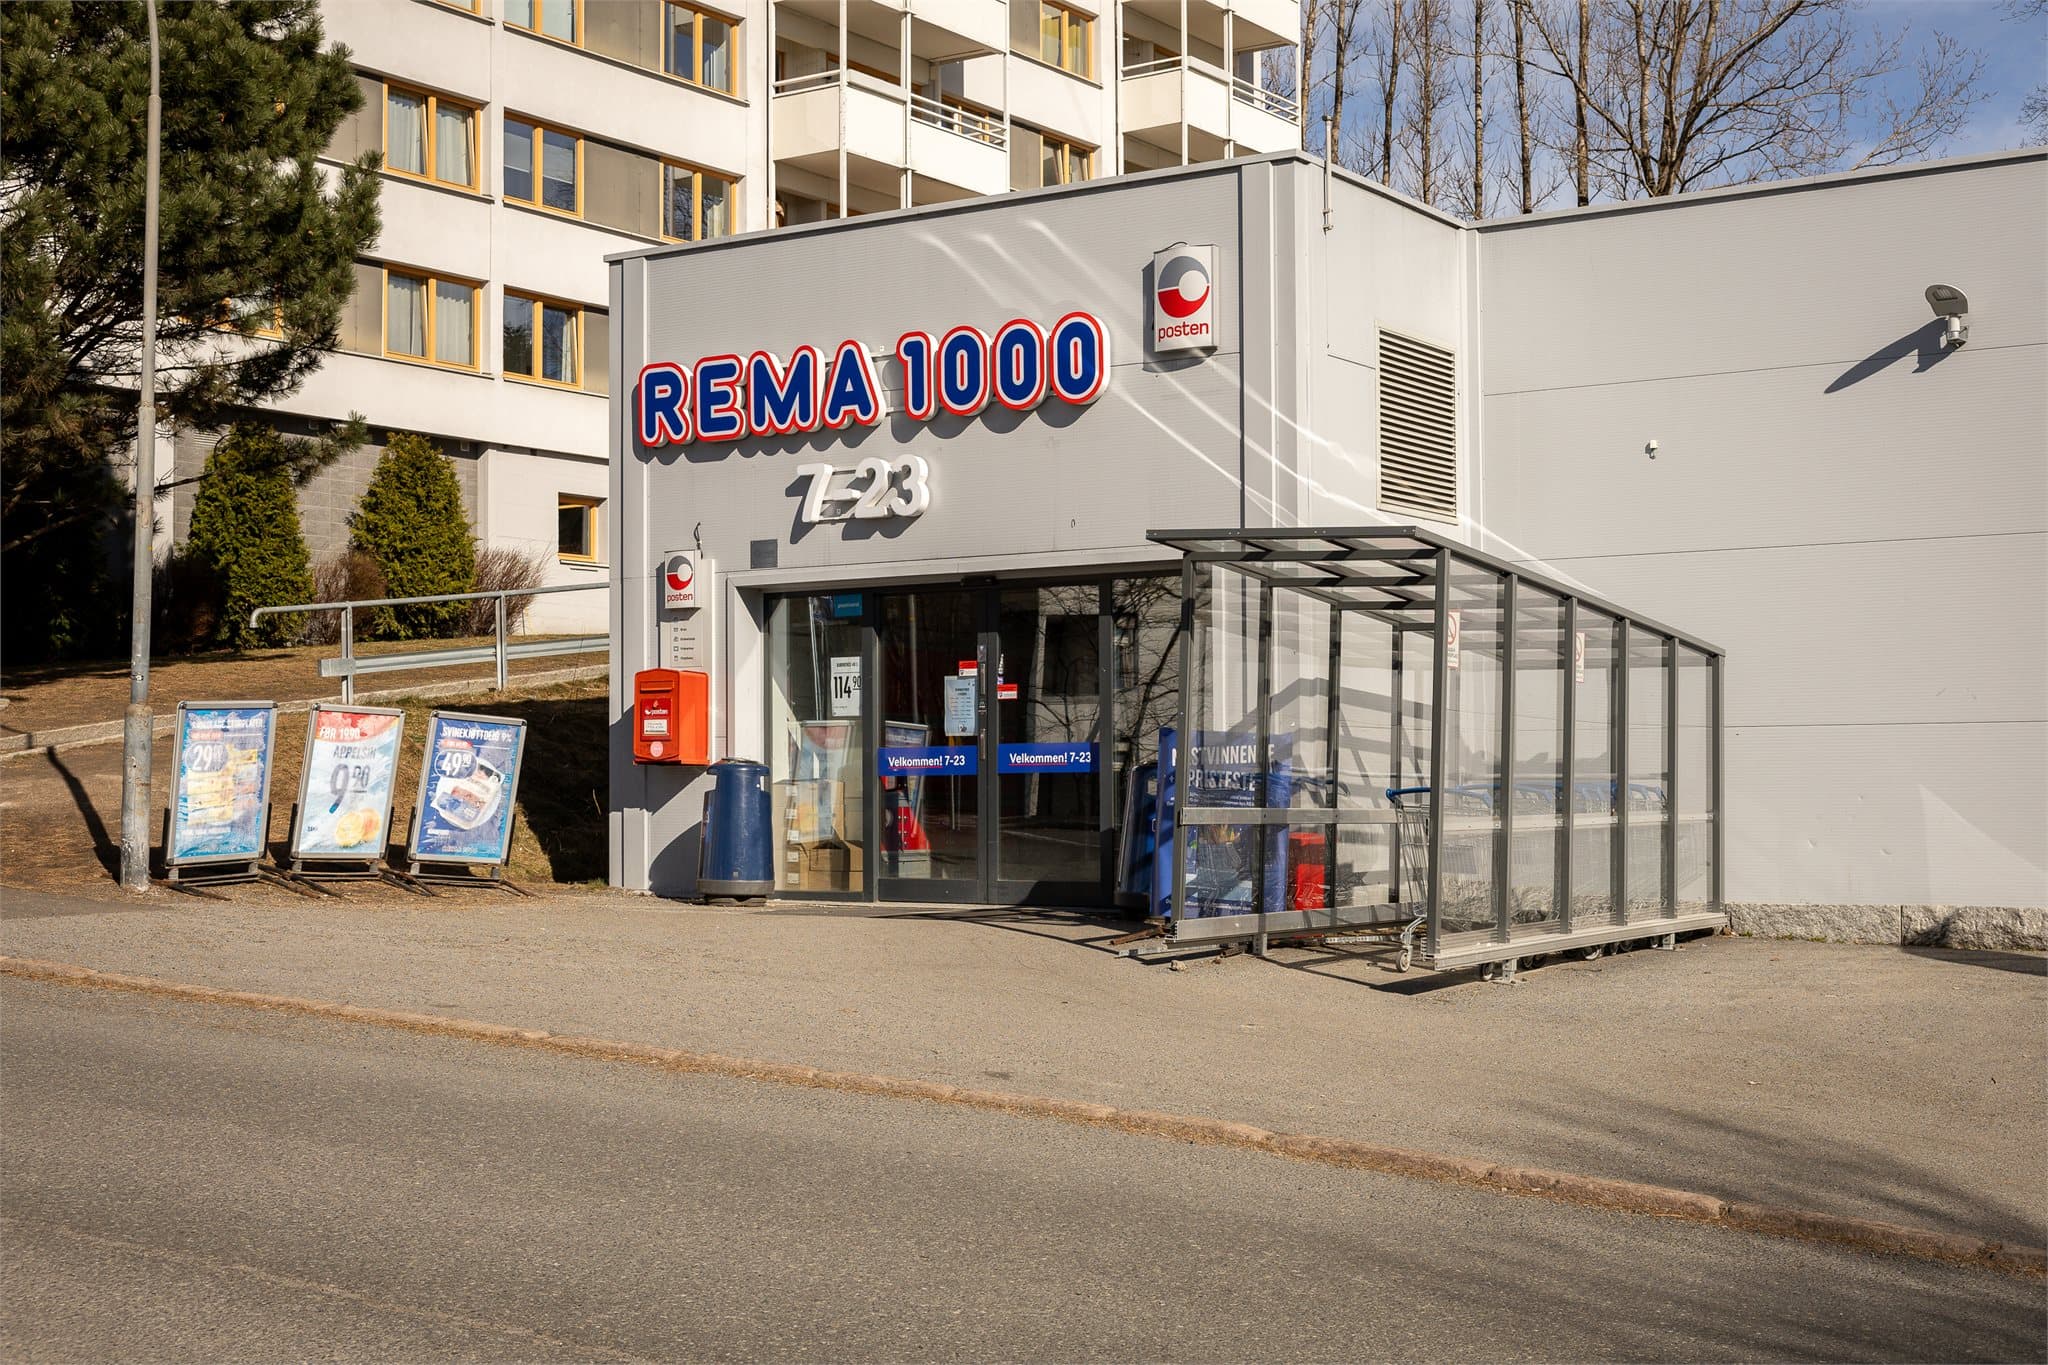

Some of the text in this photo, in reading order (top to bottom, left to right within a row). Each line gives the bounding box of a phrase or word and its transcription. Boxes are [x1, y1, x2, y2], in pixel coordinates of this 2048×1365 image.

[1159, 321, 1209, 343] posten
[638, 311, 1108, 448] REMA 1000
[797, 454, 930, 522] 7-23
[666, 592, 693, 602] posten
[888, 755, 966, 768] Velkommen! 7-23
[1009, 750, 1092, 765] Velkommen! 7-23
